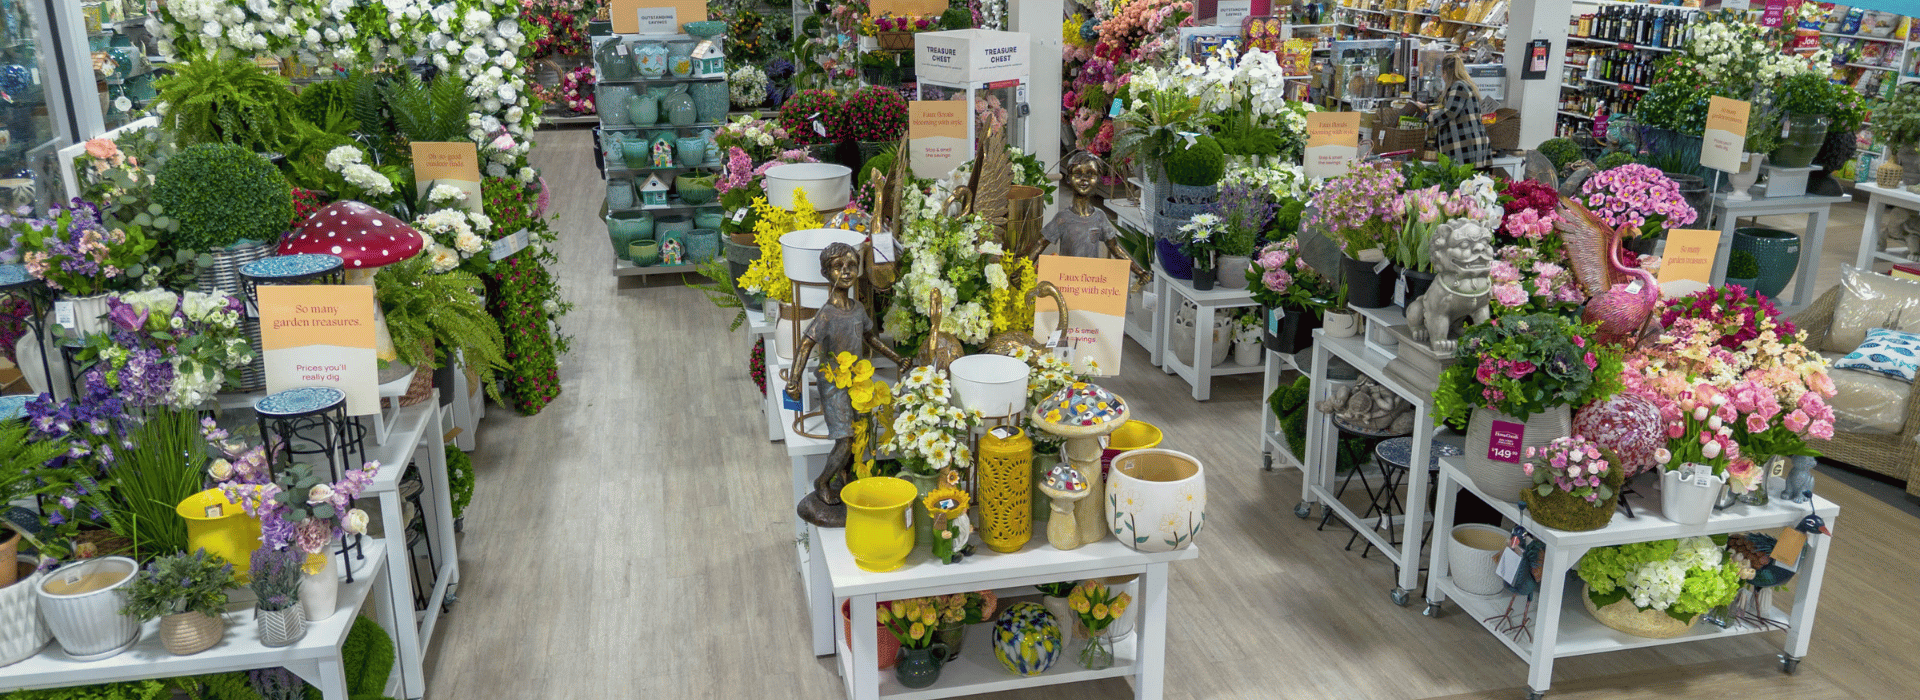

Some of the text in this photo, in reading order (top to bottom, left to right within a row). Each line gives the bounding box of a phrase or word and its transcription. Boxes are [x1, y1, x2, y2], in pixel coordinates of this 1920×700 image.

[926, 46, 956, 56] TREASURE
[984, 46, 1017, 56] TREASURE
[932, 55, 951, 63] CHEST
[990, 55, 1011, 63] CHEST
[913, 119, 938, 127] blooming
[447, 153, 462, 161] good
[1059, 272, 1107, 284] Faux florals
[1081, 285, 1099, 294] with
[1100, 287, 1121, 298] style.
[295, 304, 339, 316] So many
[273, 317, 362, 330] garden treasures.
[296, 364, 347, 373] Prices you'll
[302, 374, 325, 382] really
